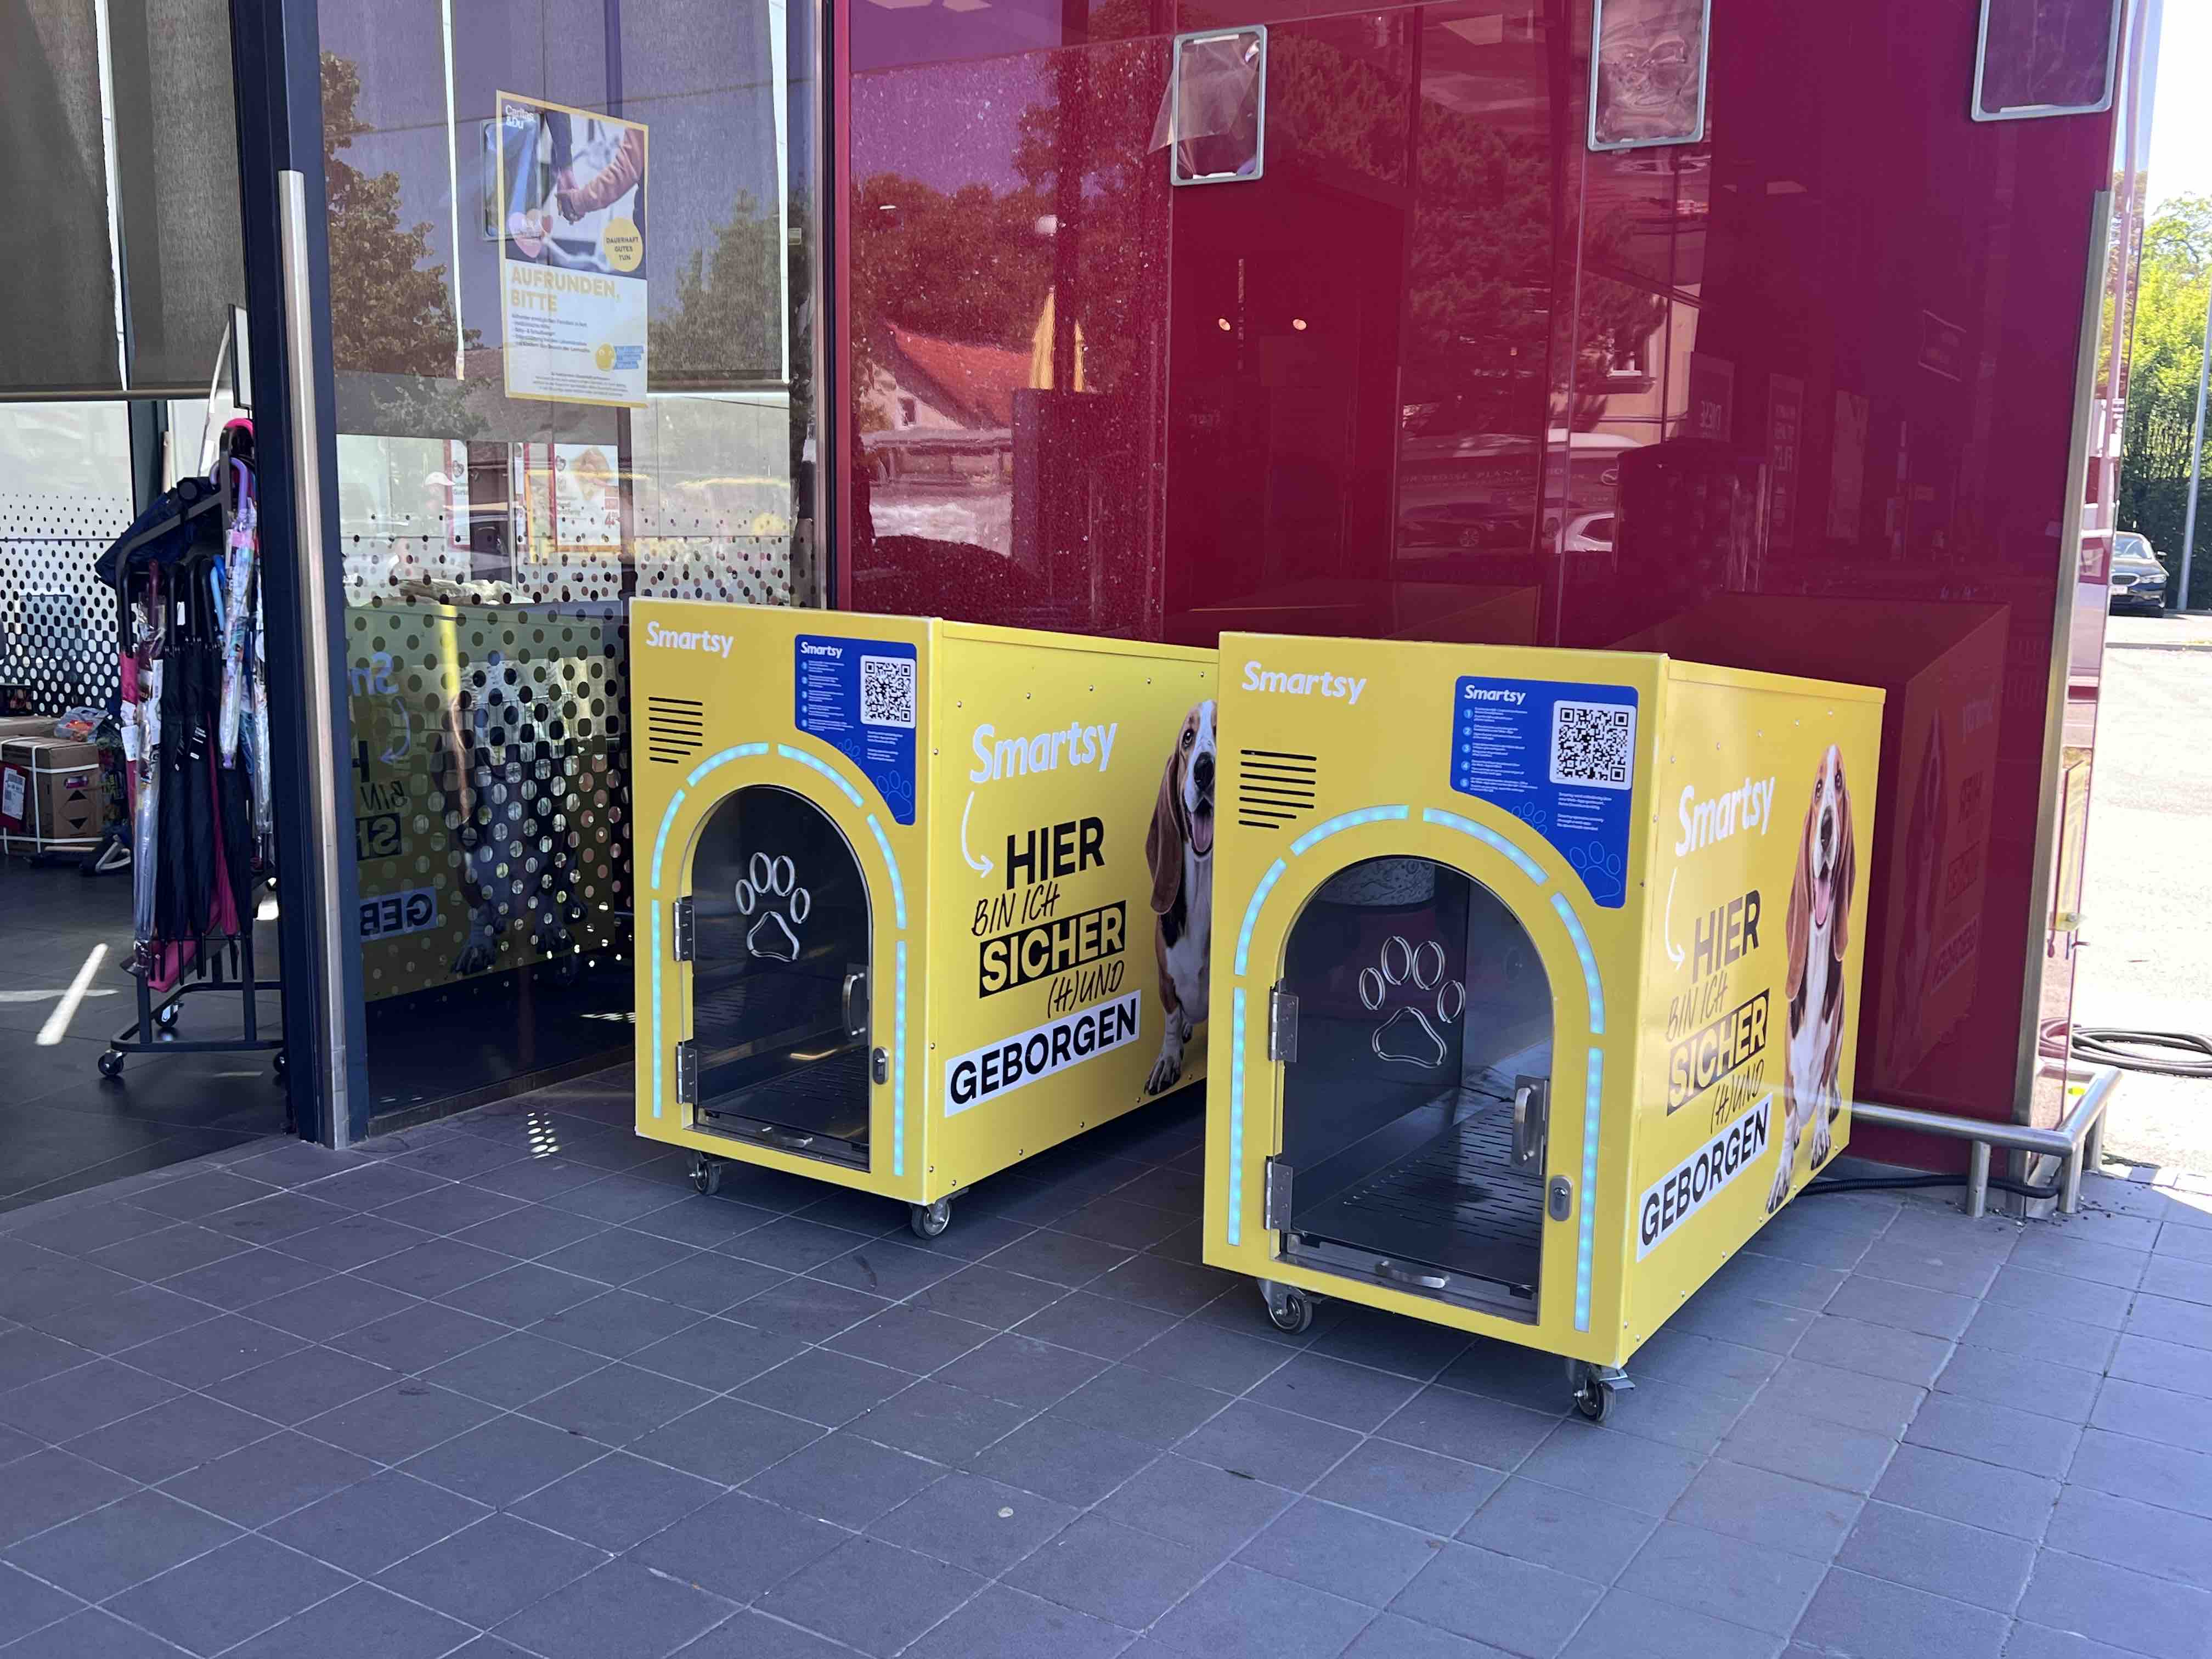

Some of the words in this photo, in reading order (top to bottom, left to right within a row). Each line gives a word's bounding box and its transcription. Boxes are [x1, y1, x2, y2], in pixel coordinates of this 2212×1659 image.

[505, 105, 535, 119] Caritas
[511, 289, 557, 312] BITTE
[512, 266, 620, 302] AUFRUNDEN,
[646, 621, 734, 658] Smartsy
[800, 642, 843, 658] Smartsy
[1242, 661, 1367, 704] Smartsy
[1464, 685, 1526, 705] Smartsy
[969, 721, 1117, 783] Smartsy
[1675, 776, 1775, 856] Smartsy
[1007, 816, 1105, 889] HIER
[971, 890, 1014, 937] BIN
[1021, 881, 1060, 926] ICH
[1692, 889, 1759, 984] HIER
[981, 905, 1123, 993] SICHER
[1047, 960, 1125, 1018] (H)UND
[1667, 988, 1699, 1042] BIN
[1699, 971, 1728, 1029] ICH
[950, 998, 1137, 1104] GEBORGEN
[1669, 996, 1767, 1110] SICHER
[1710, 1058, 1764, 1134] (H)UND
[1641, 1103, 1768, 1246] GEBORGEN
